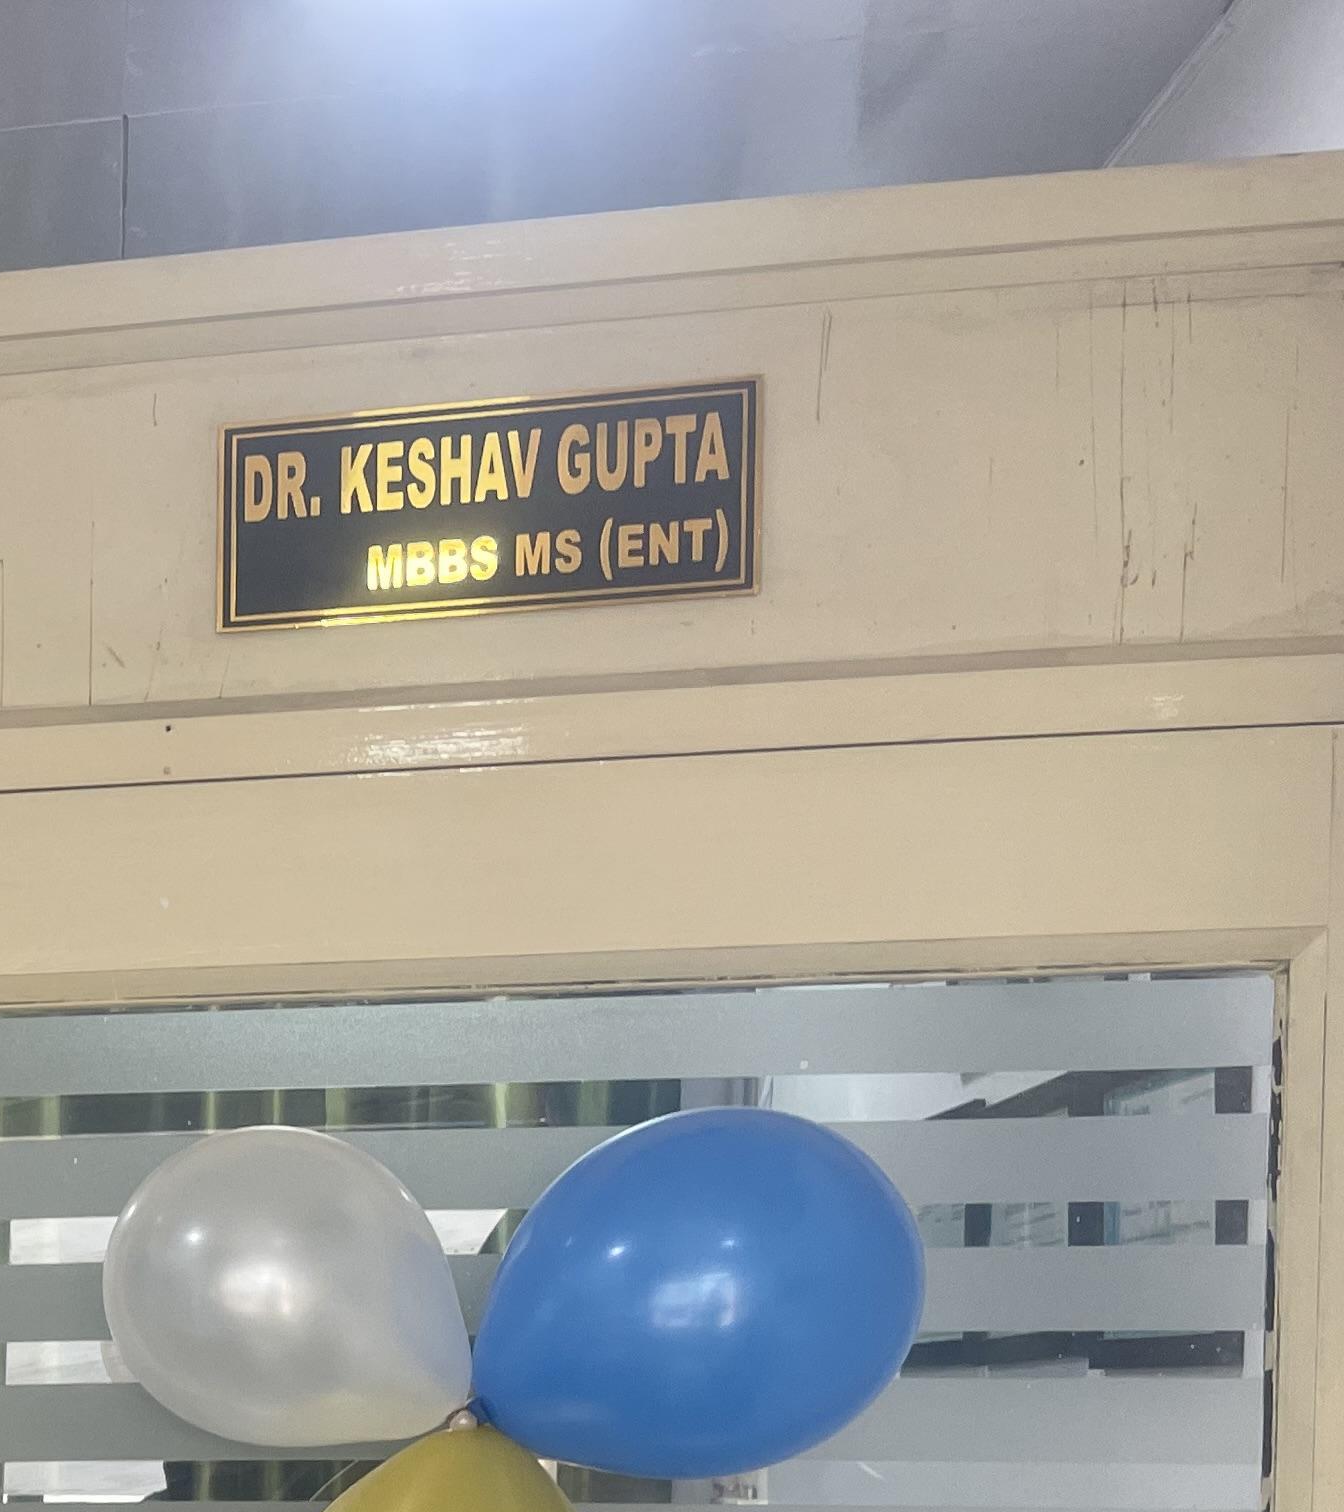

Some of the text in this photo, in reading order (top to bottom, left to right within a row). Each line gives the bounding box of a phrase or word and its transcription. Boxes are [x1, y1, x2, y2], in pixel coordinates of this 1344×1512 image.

[245, 412, 729, 521] DR. KESHAV GUPTA
[367, 509, 728, 590] MBBS MS (ENT)
